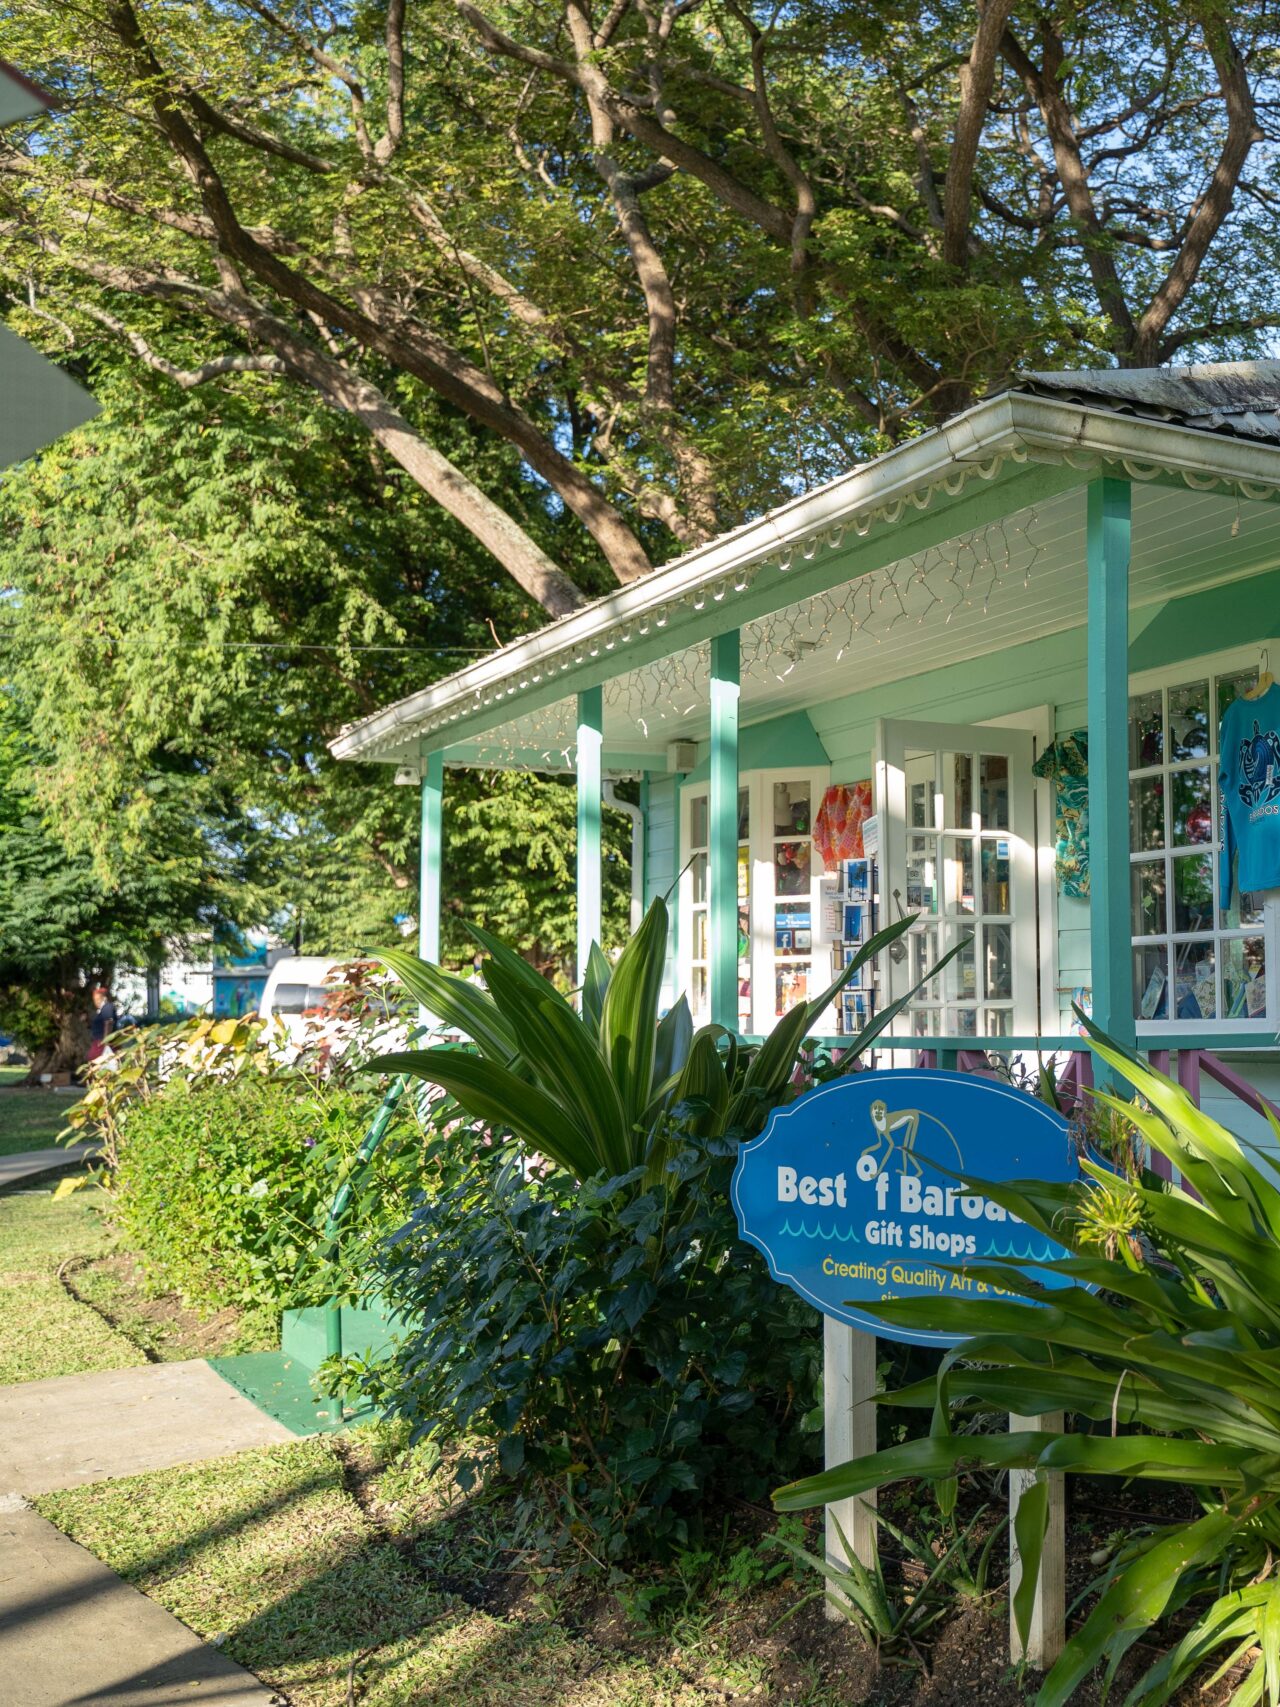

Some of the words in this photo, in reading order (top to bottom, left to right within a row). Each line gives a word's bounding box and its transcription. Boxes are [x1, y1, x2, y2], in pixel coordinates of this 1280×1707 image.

[778, 1166, 847, 1208] Best
[856, 1154, 889, 1211] of
[865, 1219, 903, 1248] Gift
[909, 1224, 977, 1258] Shops
[822, 1257, 887, 1286] Creating
[891, 1265, 947, 1291] Quality
